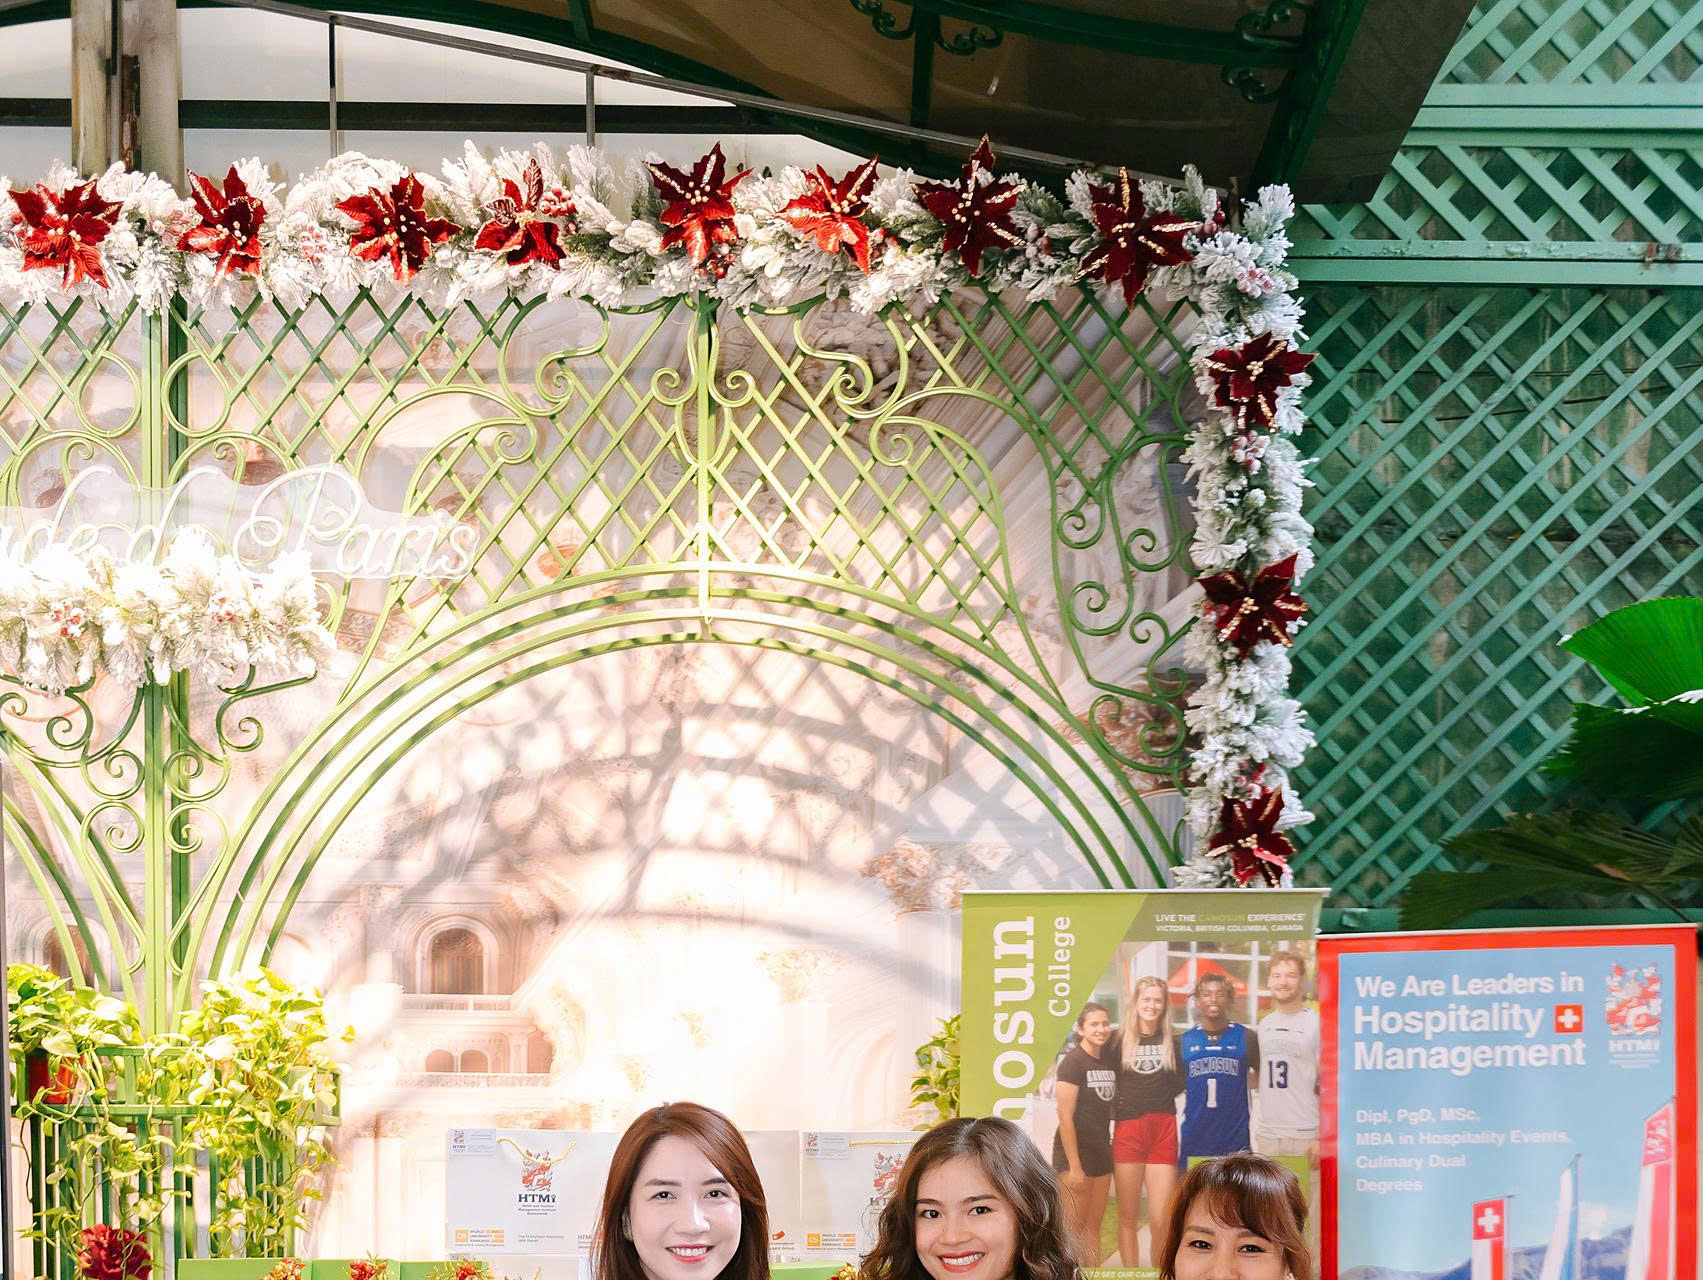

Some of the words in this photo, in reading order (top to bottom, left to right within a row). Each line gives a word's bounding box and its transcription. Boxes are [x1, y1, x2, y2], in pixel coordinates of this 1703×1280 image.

[1178, 914, 1197, 922] THE
[1048, 917, 1076, 1016] College
[1355, 976, 1396, 998] We
[1401, 975, 1446, 997] Are
[1452, 973, 1554, 996] Leaders
[1560, 972, 1584, 993] in
[1354, 1002, 1544, 1040] Hospitality
[1189, 1057, 1239, 1077] CAMOSUN
[1354, 1038, 1586, 1077] Management
[1268, 1060, 1288, 1089] 13
[1206, 1079, 1217, 1108] 1
[1356, 1132, 1394, 1145] MBA
[1399, 1132, 1414, 1145] in
[1419, 1130, 1505, 1147] Hospitality
[1356, 1155, 1423, 1170] Culinary
[1429, 1154, 1466, 1168] Dual
[1356, 1178, 1423, 1194] Degrees
